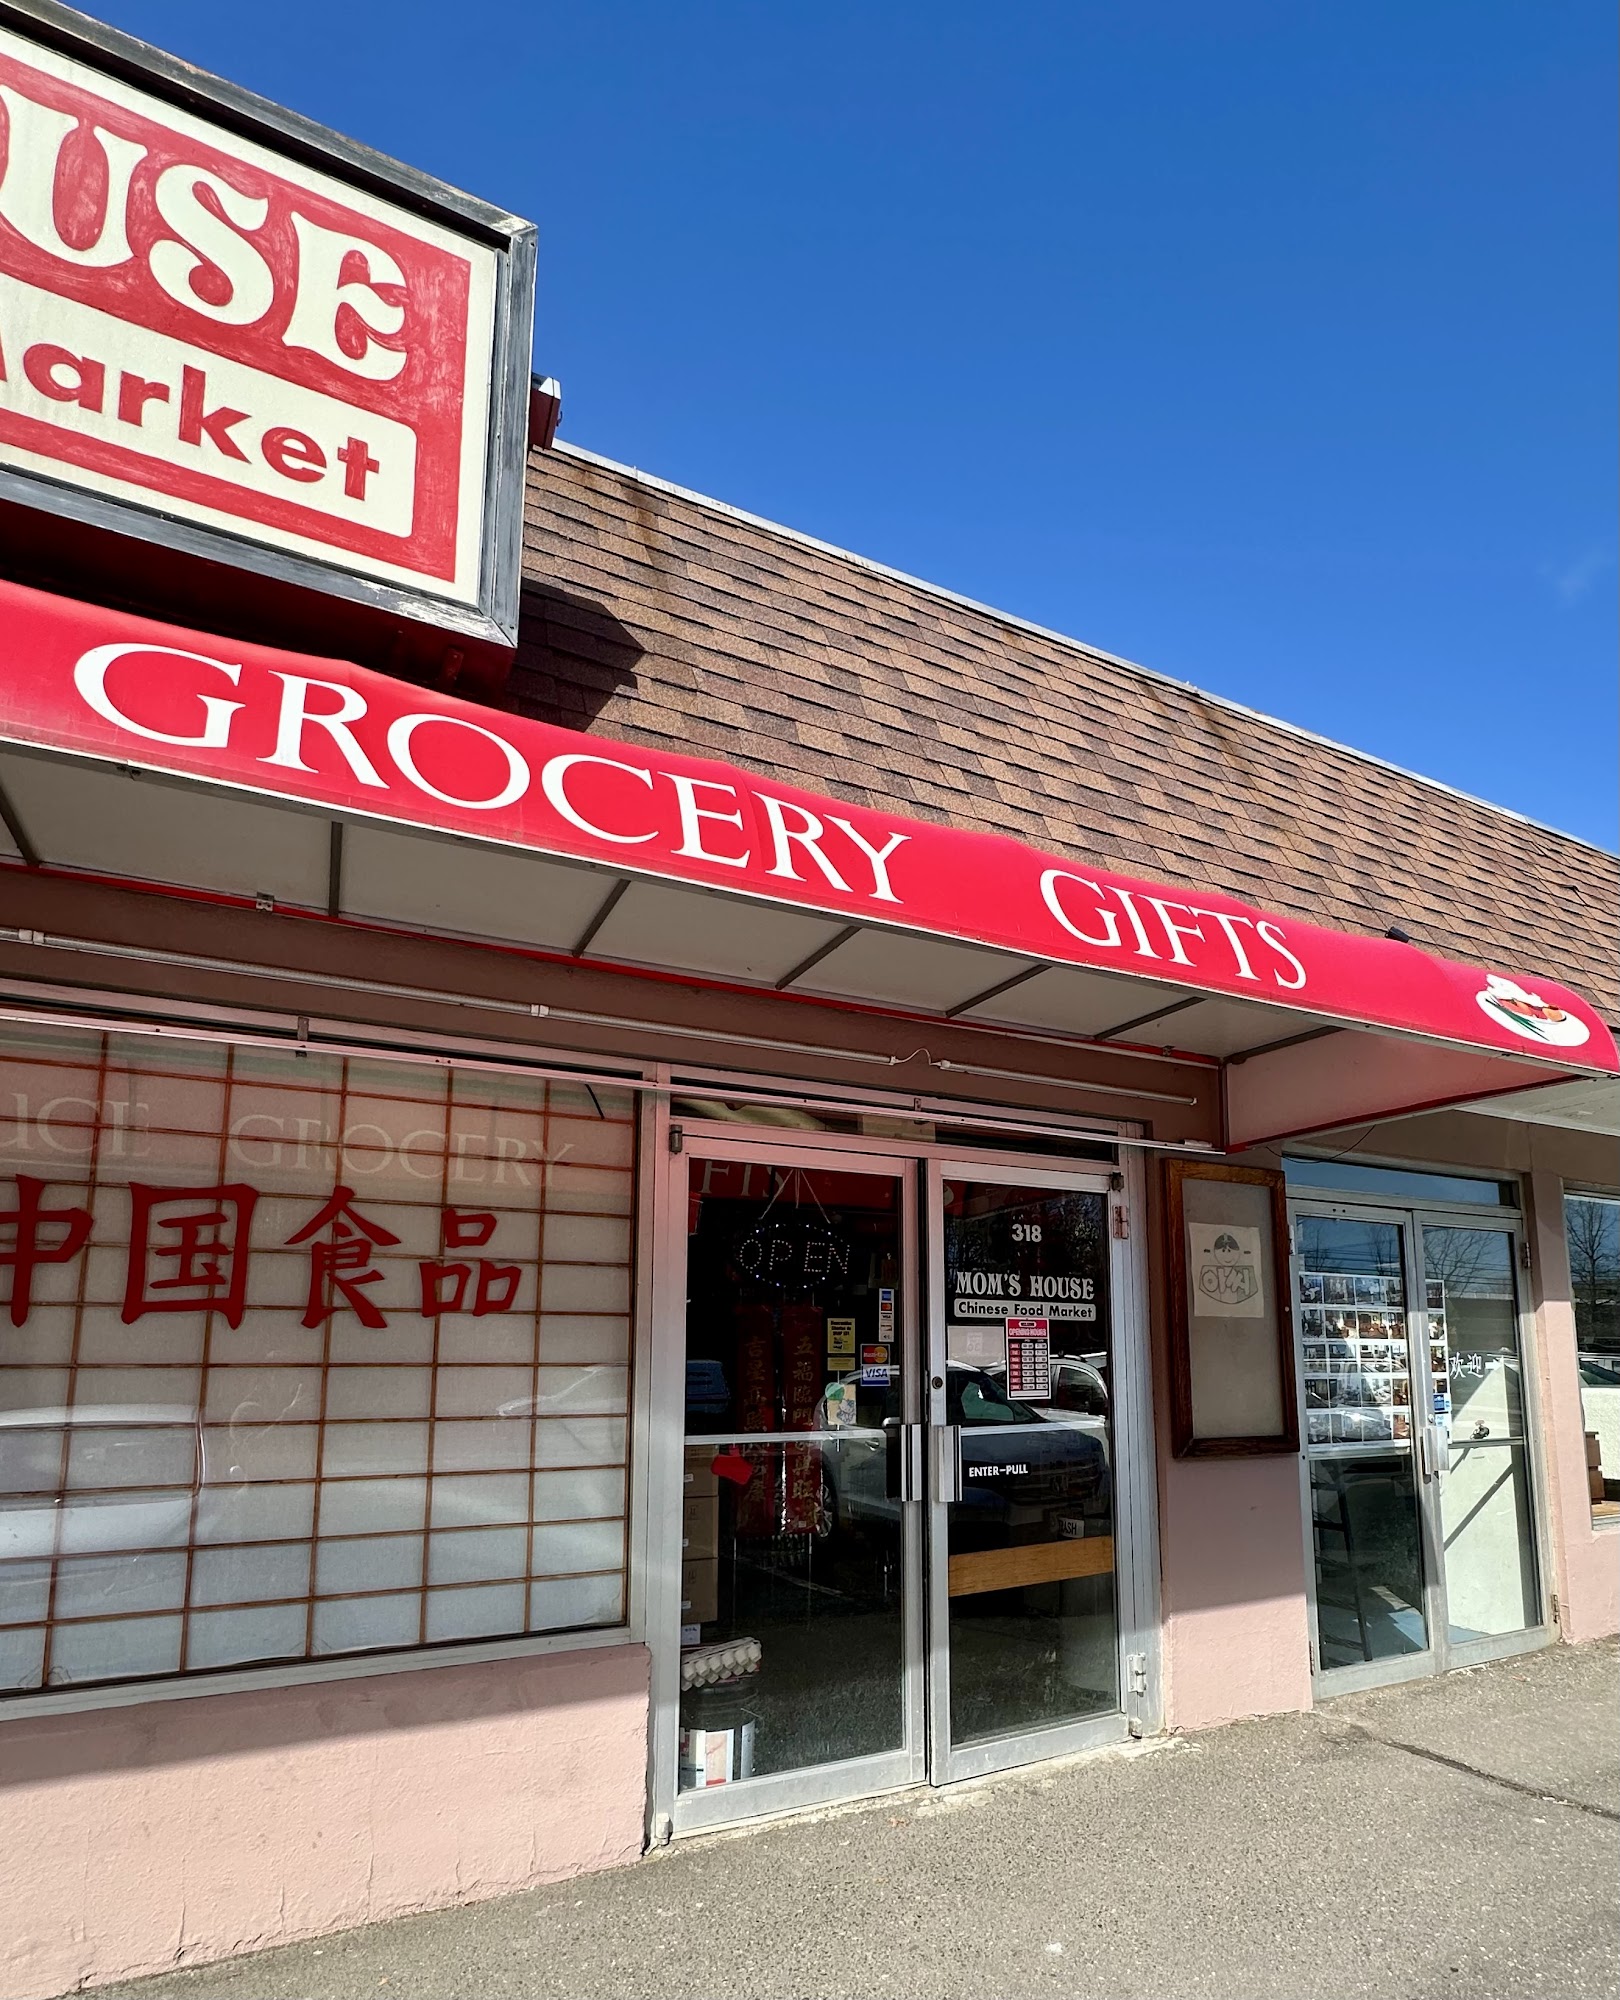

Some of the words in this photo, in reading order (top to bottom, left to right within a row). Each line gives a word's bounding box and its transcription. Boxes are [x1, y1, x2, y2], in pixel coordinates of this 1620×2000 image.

[0, 84, 408, 381] USE
[0, 331, 380, 501] arket
[74, 642, 911, 904] GROCERY
[1039, 869, 1307, 990] GIFTS
[228, 1113, 575, 1187] GROCERY
[1011, 1223, 1042, 1243] 318
[0, 1173, 522, 1332] 中国食品
[739, 1238, 850, 1275] OPEN
[955, 1271, 1022, 1297] MOM'S
[1029, 1275, 1095, 1300] HOUSE
[958, 1301, 1009, 1315] Chinese
[1014, 1303, 1044, 1316] Food
[1049, 1305, 1093, 1318] Market
[865, 1368, 888, 1378] VISA
[1448, 1351, 1484, 1380] 欢迎
[968, 1463, 1029, 1478] ENTER-PULL
